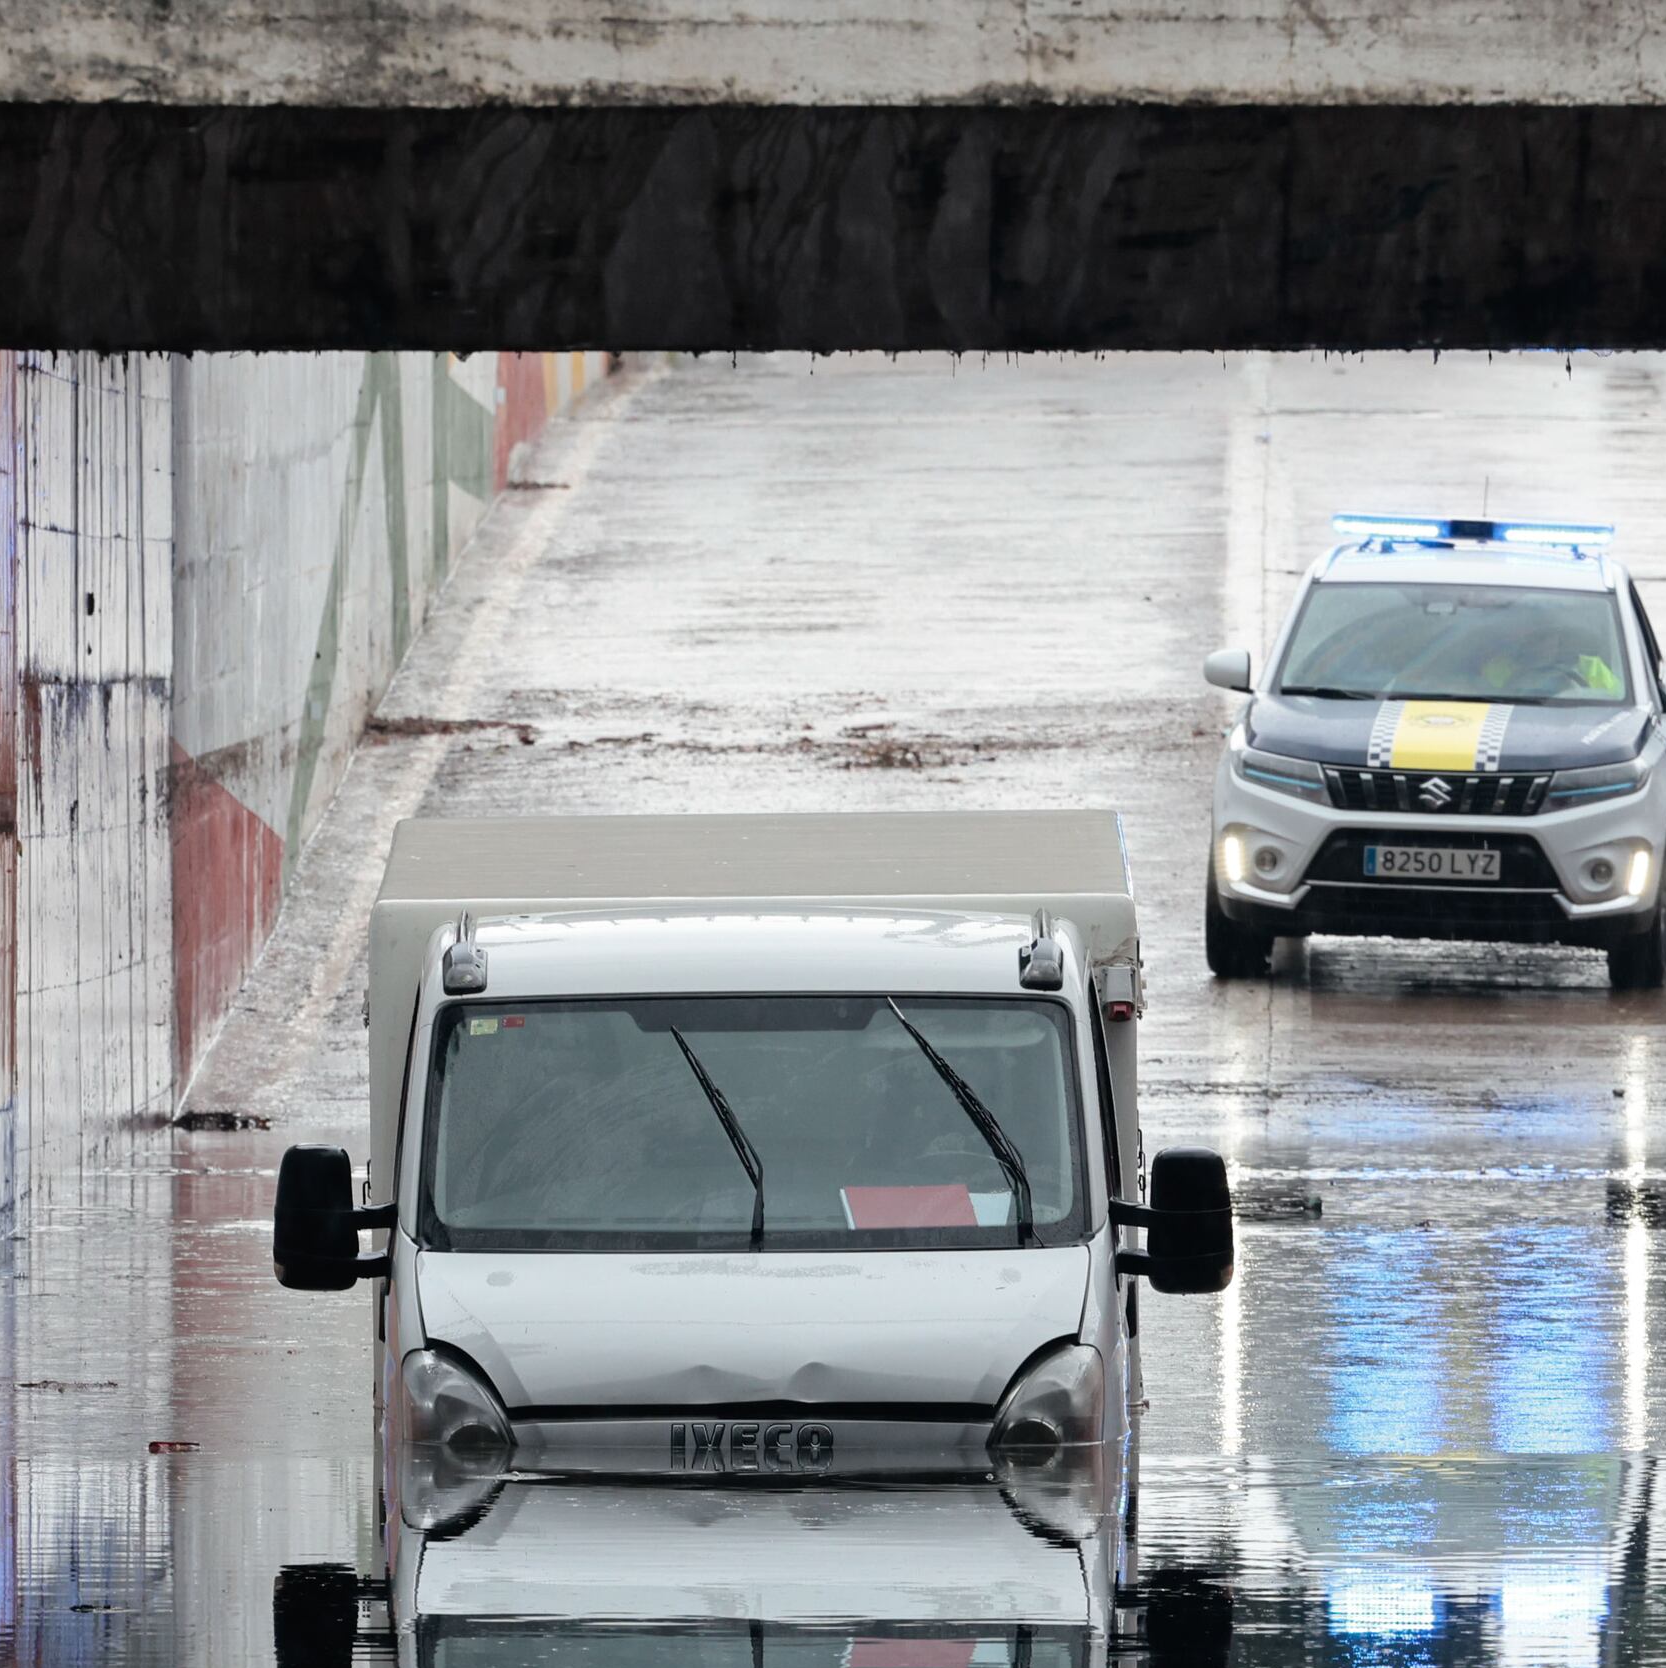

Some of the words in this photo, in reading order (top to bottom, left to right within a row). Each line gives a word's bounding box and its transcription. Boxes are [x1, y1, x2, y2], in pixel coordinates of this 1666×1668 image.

[1383, 850, 1442, 873] 8250
[1450, 853, 1495, 876] LYZ
[670, 1423, 834, 1450] IVECO
